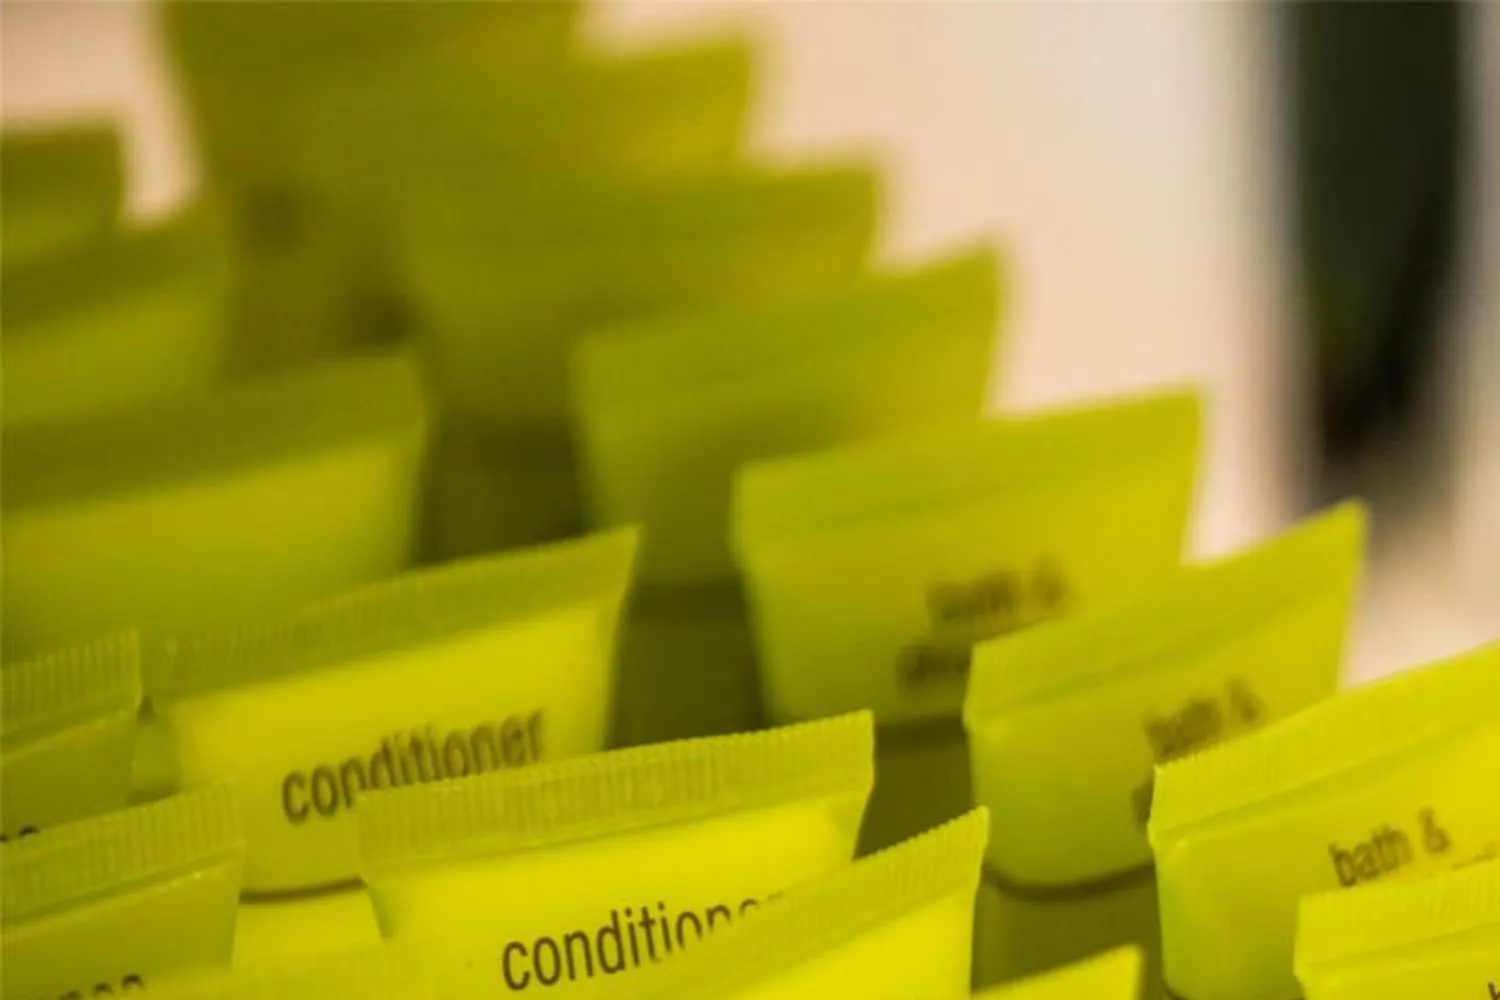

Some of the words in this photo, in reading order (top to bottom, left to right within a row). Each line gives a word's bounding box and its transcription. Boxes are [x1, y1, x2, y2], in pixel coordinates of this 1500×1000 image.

[281, 707, 545, 826] conditioner
[1328, 823, 1413, 888] bath
[501, 890, 784, 991] condition
